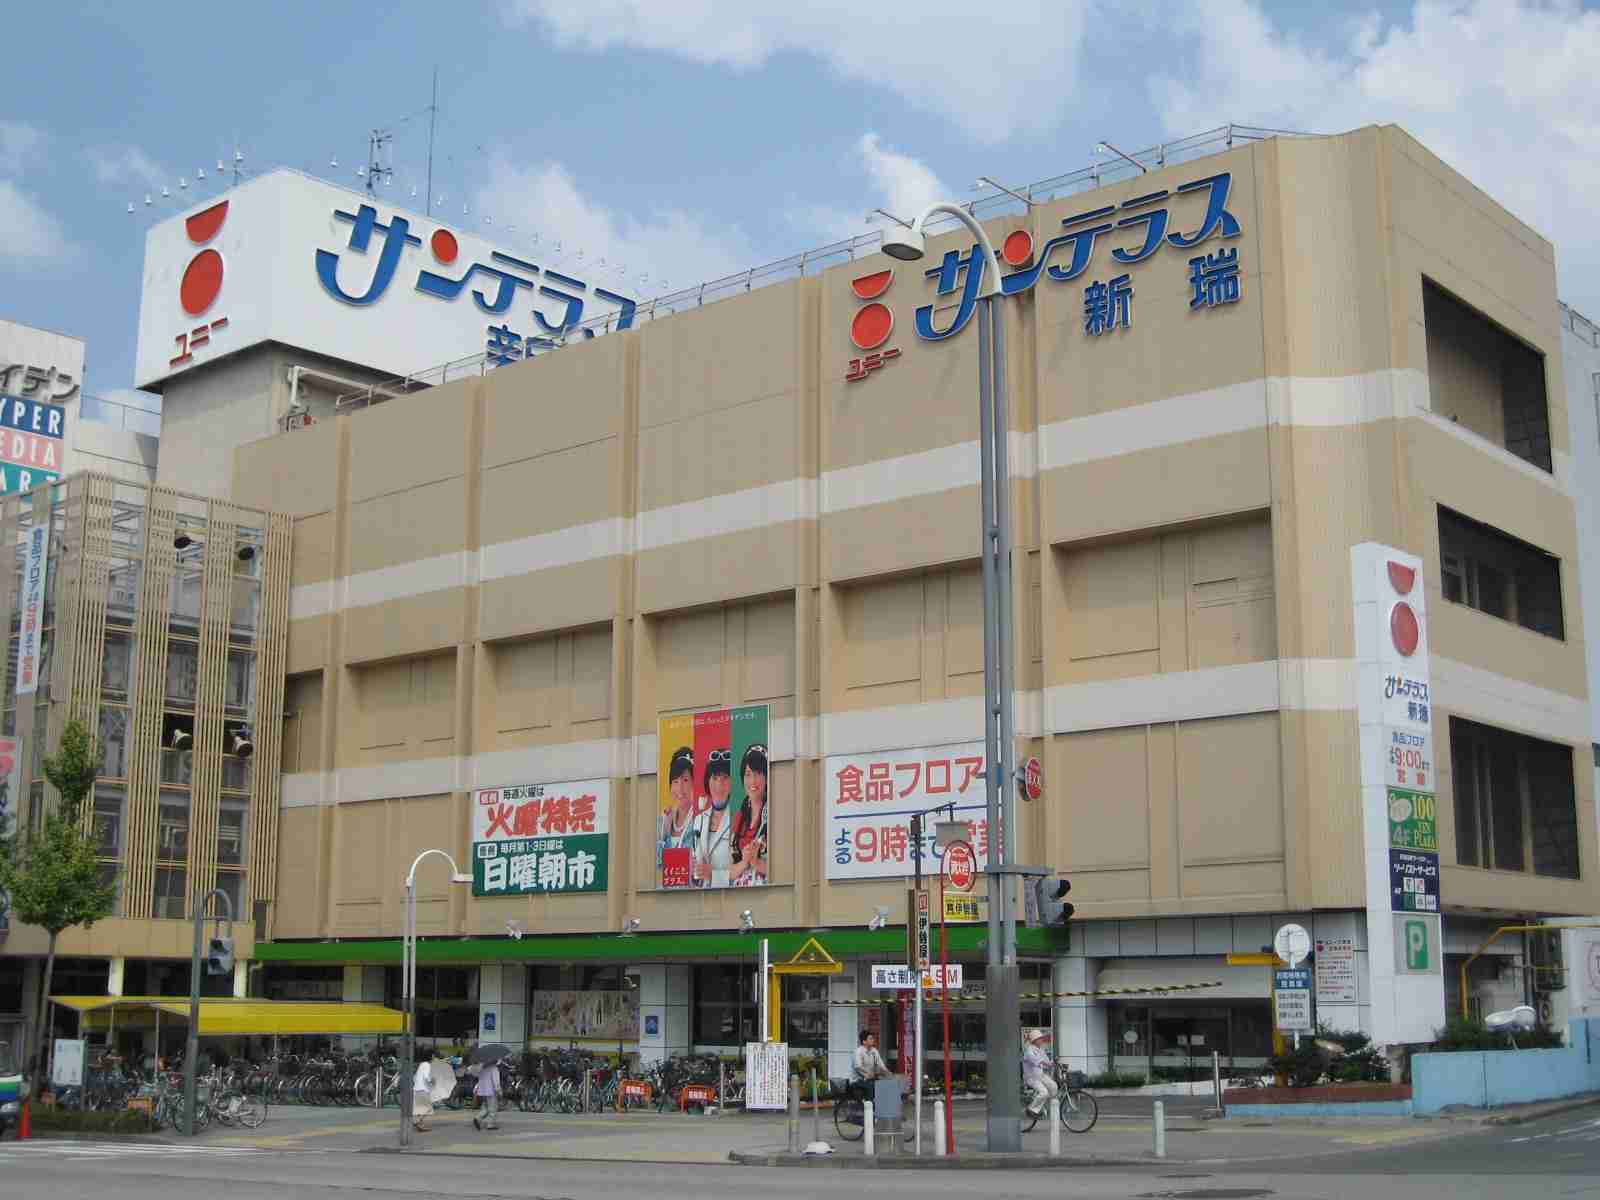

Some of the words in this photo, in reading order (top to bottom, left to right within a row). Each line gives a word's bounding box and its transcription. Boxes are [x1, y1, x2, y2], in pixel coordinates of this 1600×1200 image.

[914, 172, 1242, 341] サンテラス
[169, 317, 228, 366] ユニー
[845, 347, 902, 383] ユニー
[484, 794, 597, 838] 火曜特売
[483, 850, 597, 892] 日曜朝市
[1408, 925, 1425, 968] P
